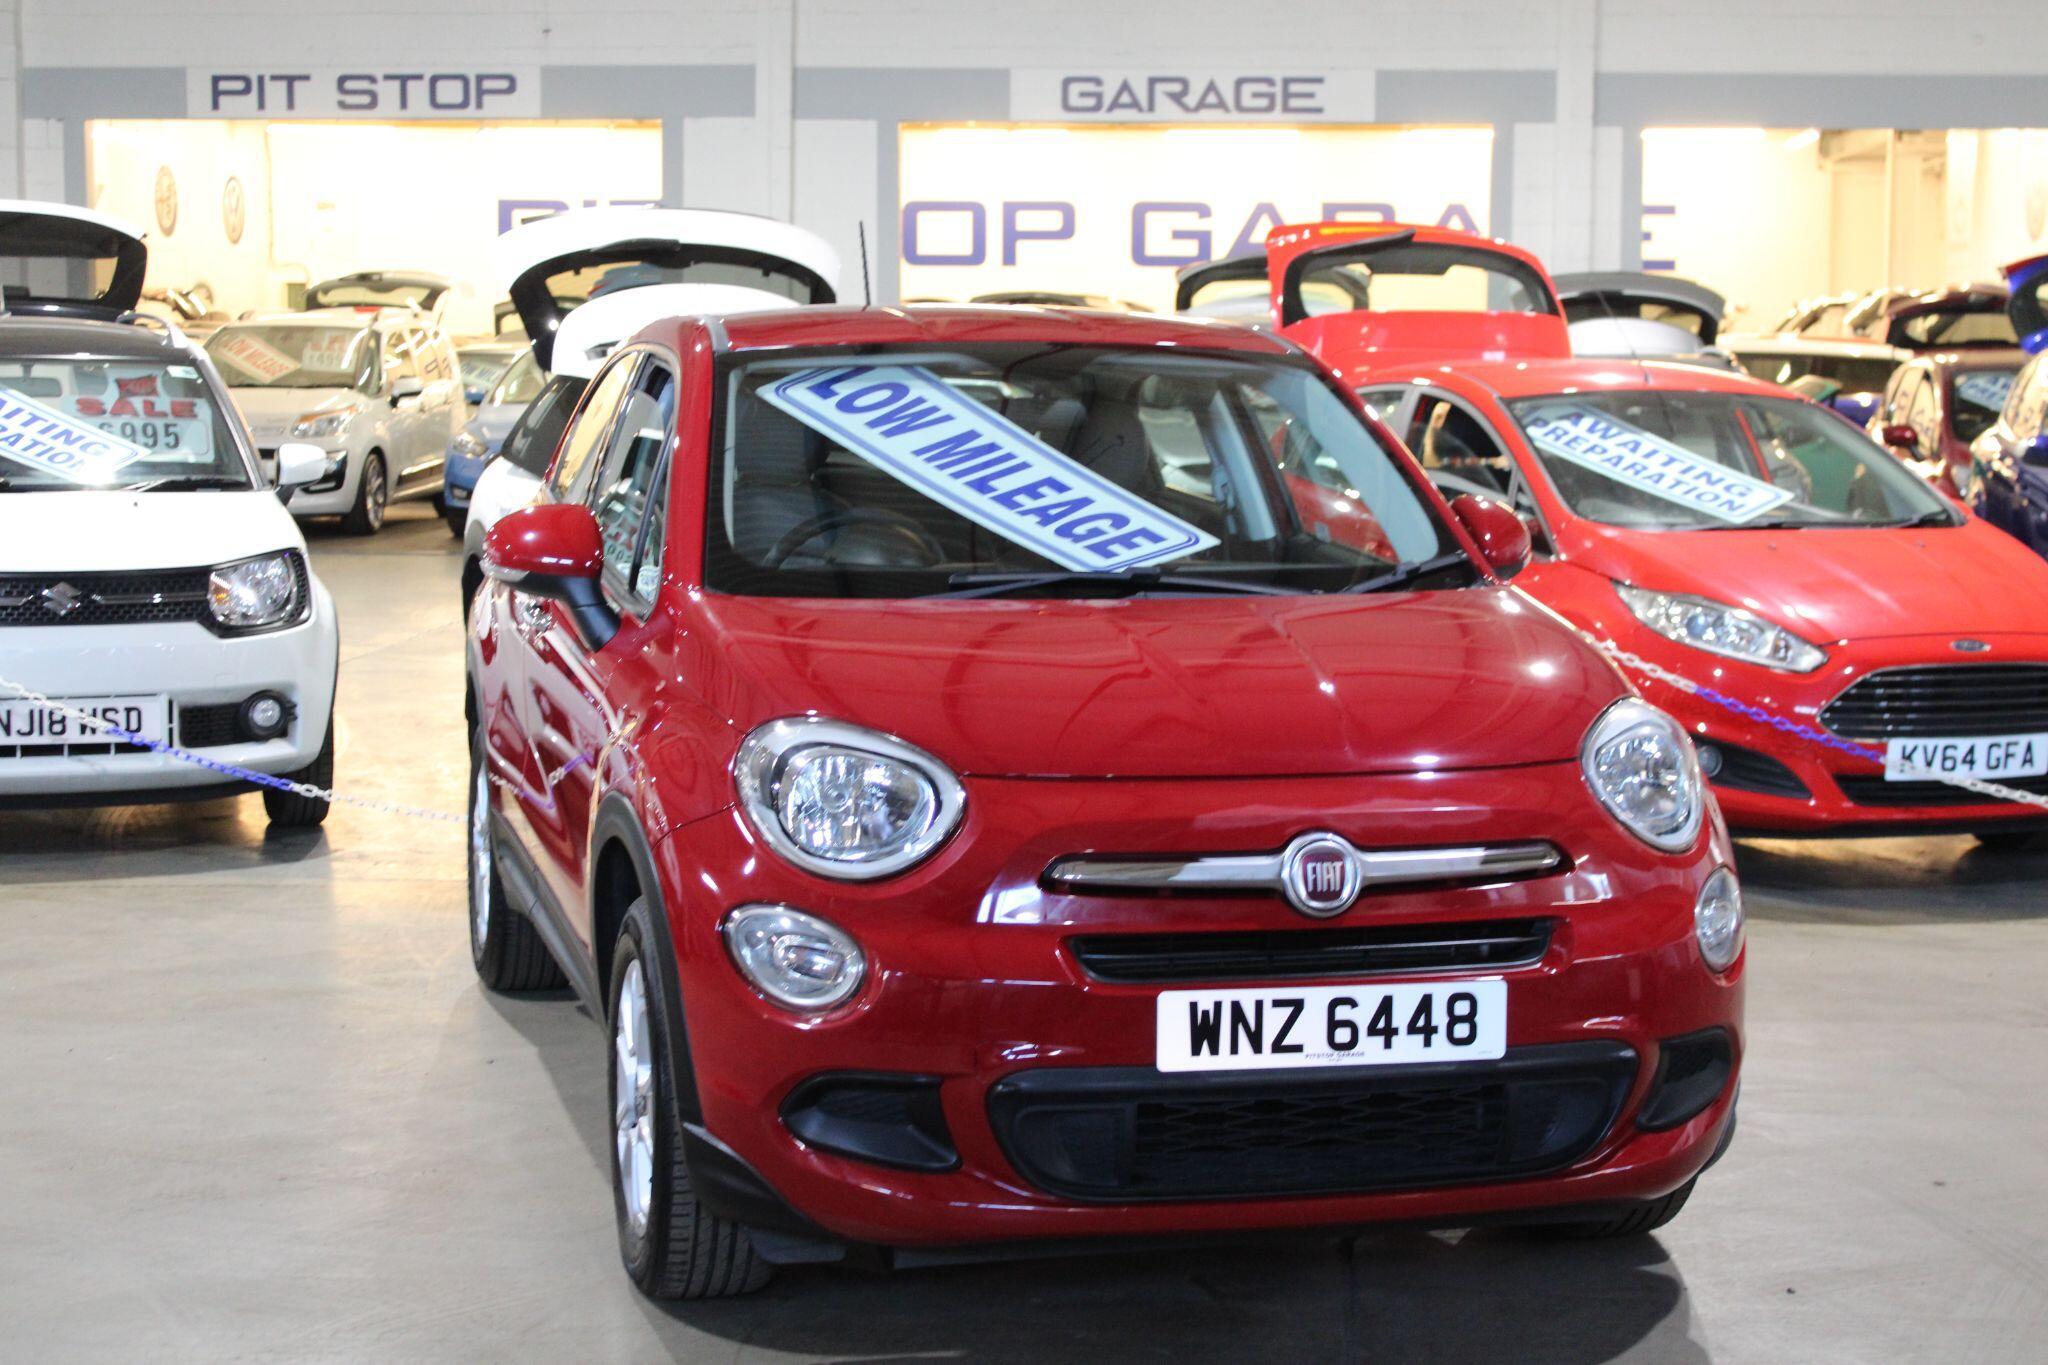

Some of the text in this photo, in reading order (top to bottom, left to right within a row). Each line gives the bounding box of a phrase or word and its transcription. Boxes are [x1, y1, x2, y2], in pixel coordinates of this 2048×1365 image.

[210, 74, 517, 111] PIT STOP
[1061, 76, 1325, 114] GARAGE
[76, 397, 199, 418] SALE
[806, 365, 1166, 559] LOW MILEAGE
[1530, 417, 1744, 512] PREPARATION
[1556, 411, 1753, 498] AWAITING
[1901, 741, 2035, 772] KV64 GFA
[1306, 861, 1344, 893] FIAT
[1189, 992, 1478, 1057] WNZ 6448
